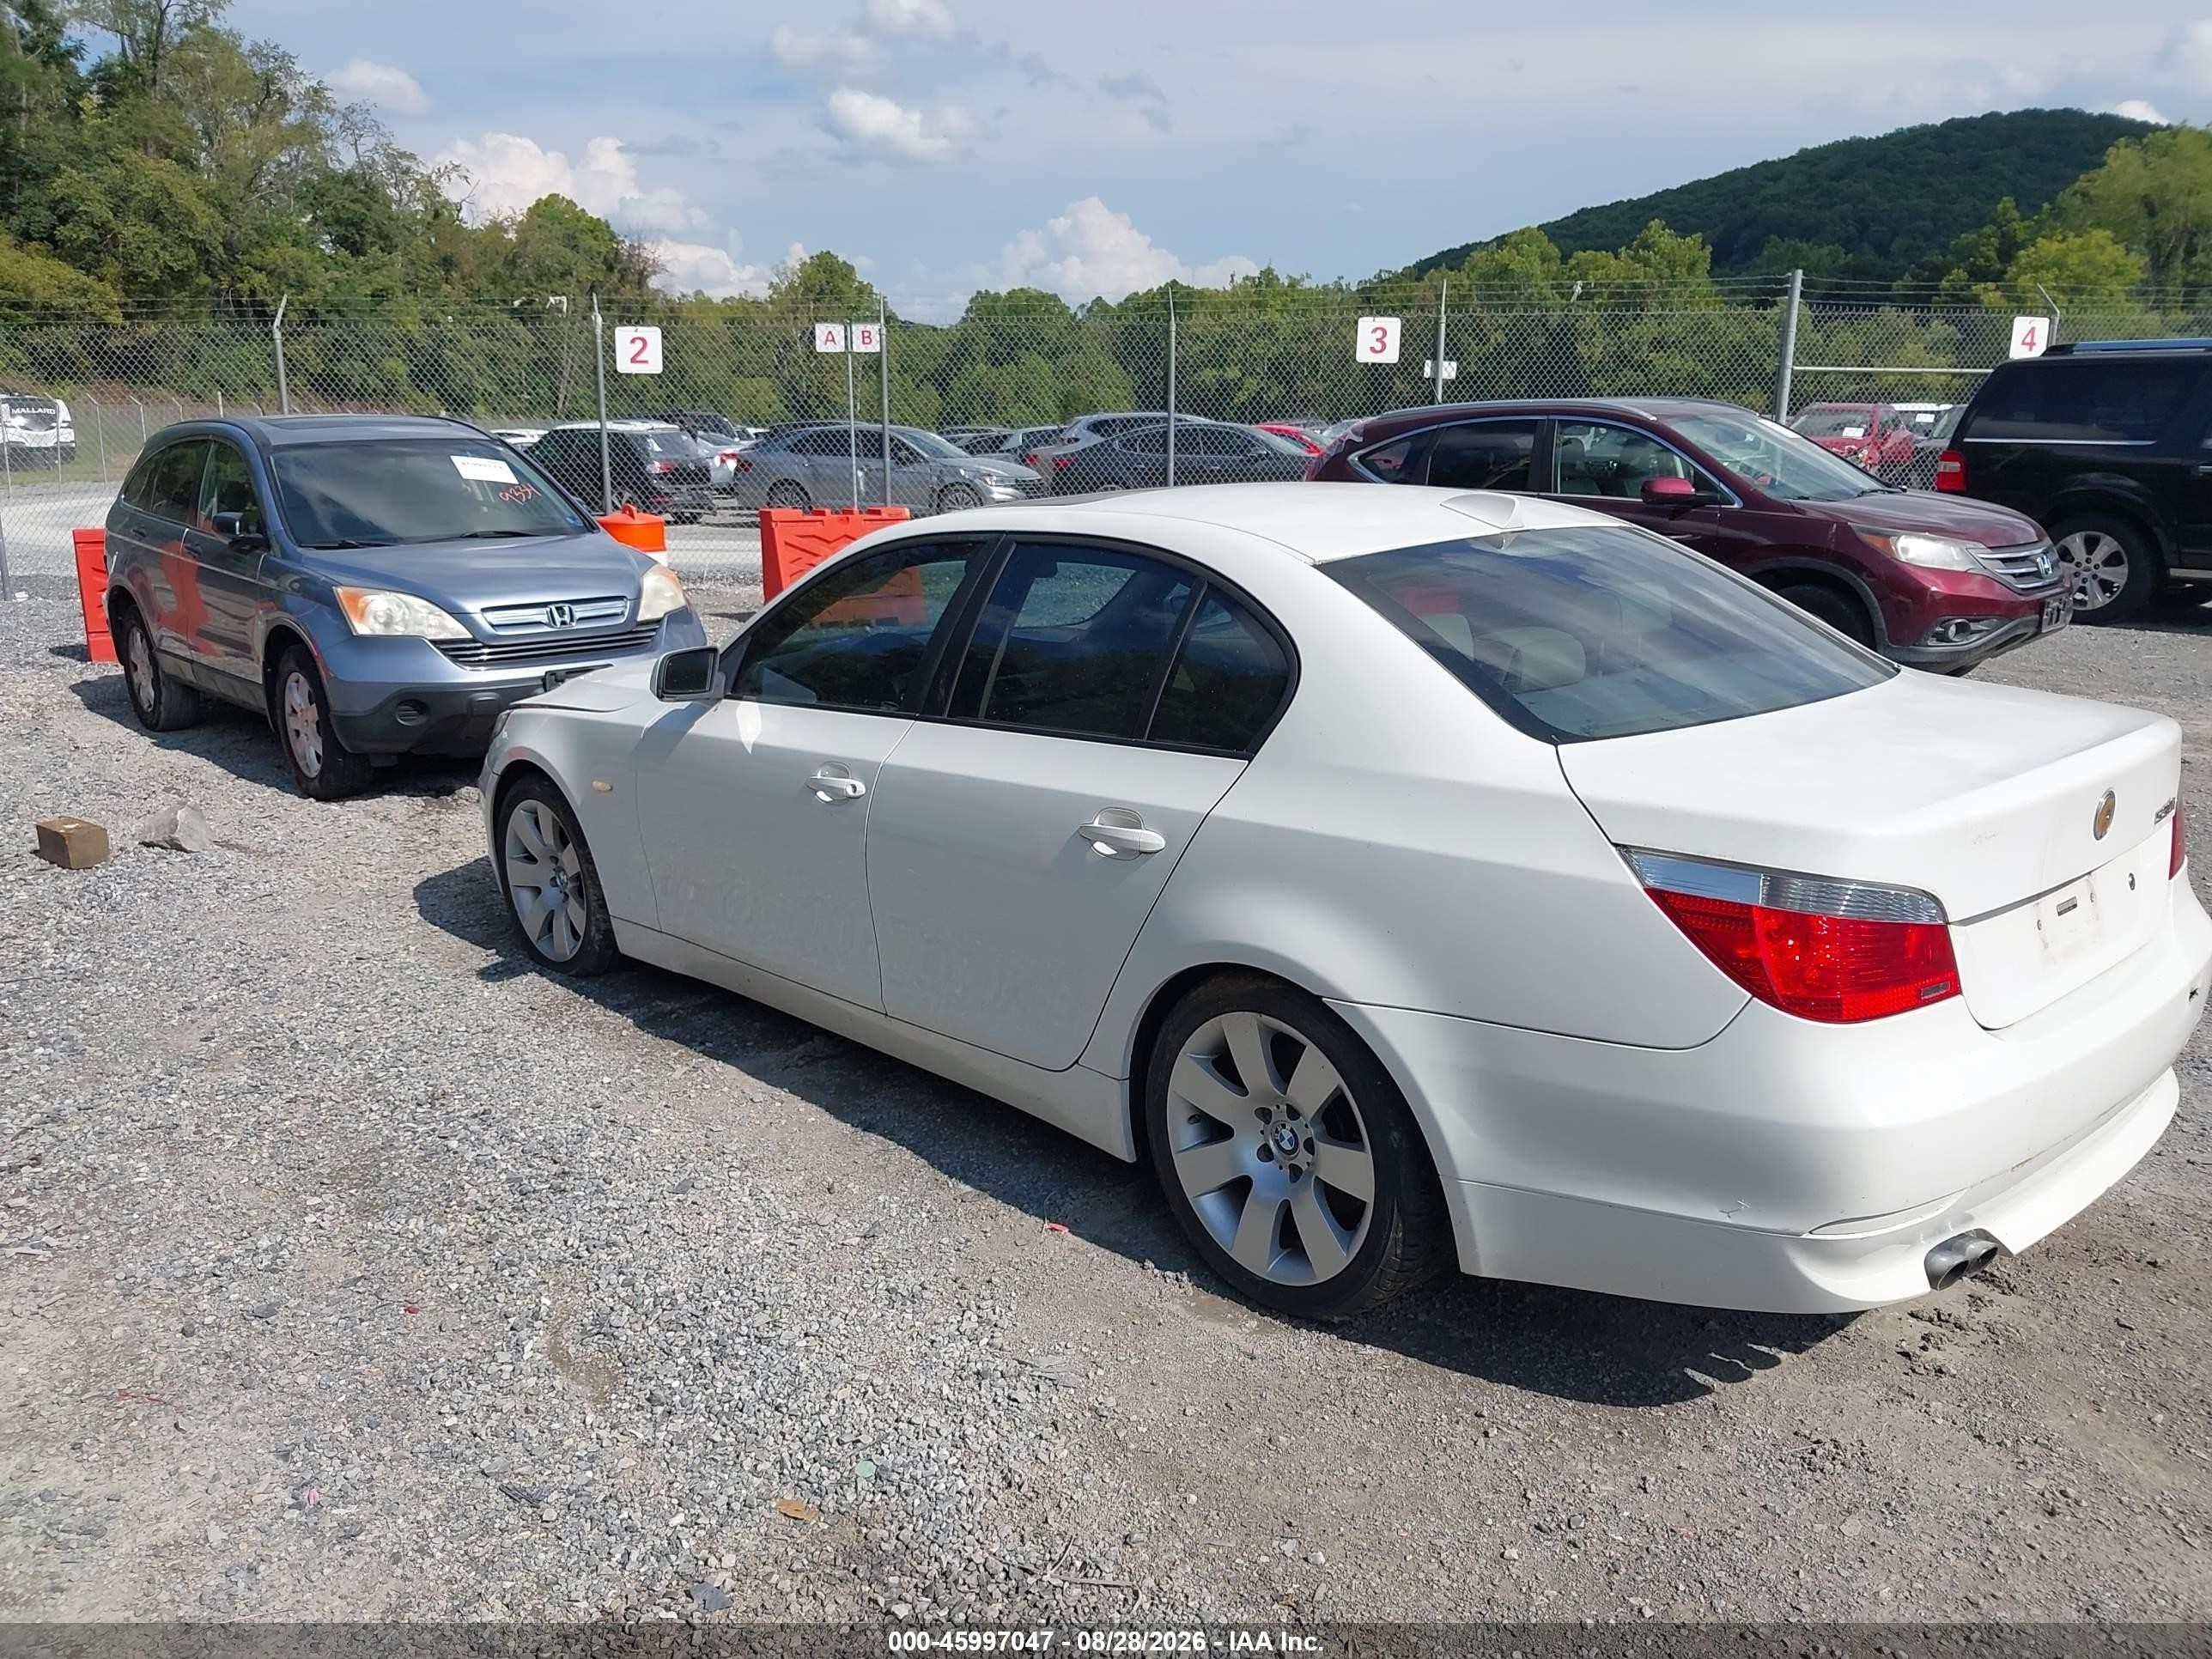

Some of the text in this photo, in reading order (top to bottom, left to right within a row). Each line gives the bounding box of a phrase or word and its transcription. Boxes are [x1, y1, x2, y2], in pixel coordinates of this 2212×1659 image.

[629, 336, 649, 364] 2
[823, 330, 836, 345] A
[861, 330, 872, 345] B
[1369, 326, 1388, 355] 3
[2020, 325, 2037, 352] 4
